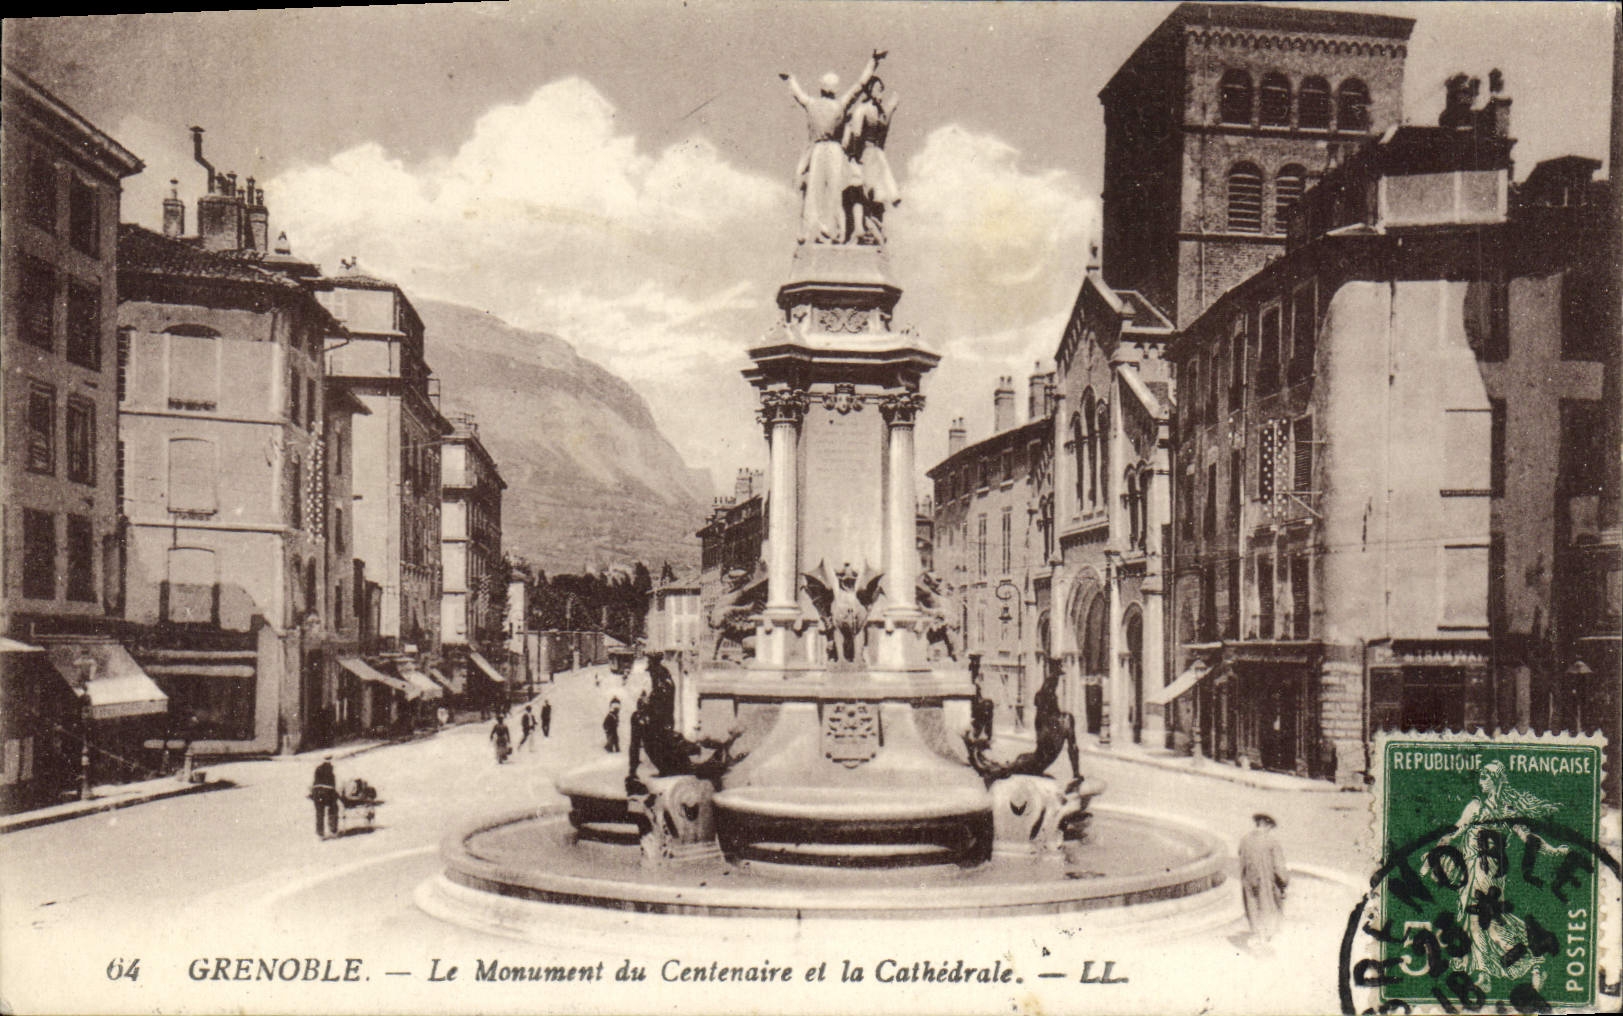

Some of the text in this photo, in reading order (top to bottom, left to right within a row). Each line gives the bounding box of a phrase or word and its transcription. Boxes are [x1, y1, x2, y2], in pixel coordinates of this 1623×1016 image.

[1393, 752, 1591, 776] REPUBLIQUE FRANÇAISE
[1565, 907, 1588, 993] POSTES
